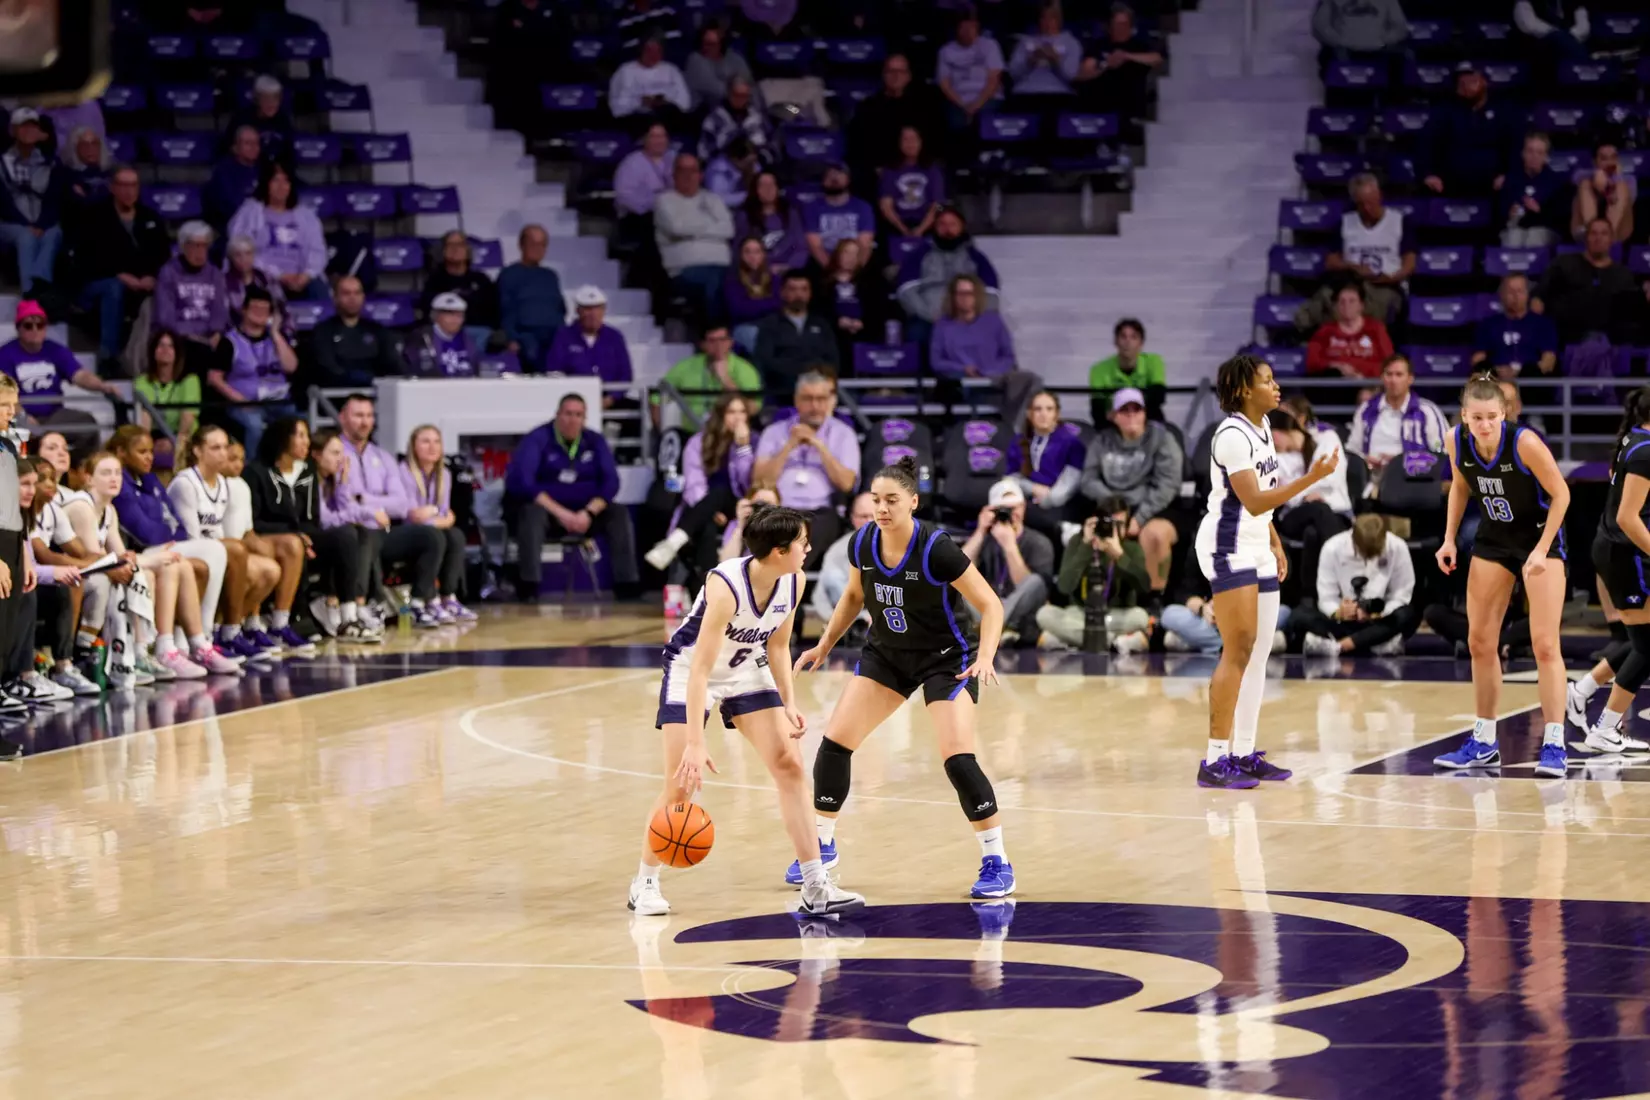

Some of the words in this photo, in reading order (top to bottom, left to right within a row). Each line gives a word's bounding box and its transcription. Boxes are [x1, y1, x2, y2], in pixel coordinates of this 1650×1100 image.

[1476, 475, 1505, 495] BYU
[1482, 496, 1514, 522] 13
[874, 582, 904, 607] BYU
[882, 607, 908, 634] 8
[728, 648, 753, 668] 6
